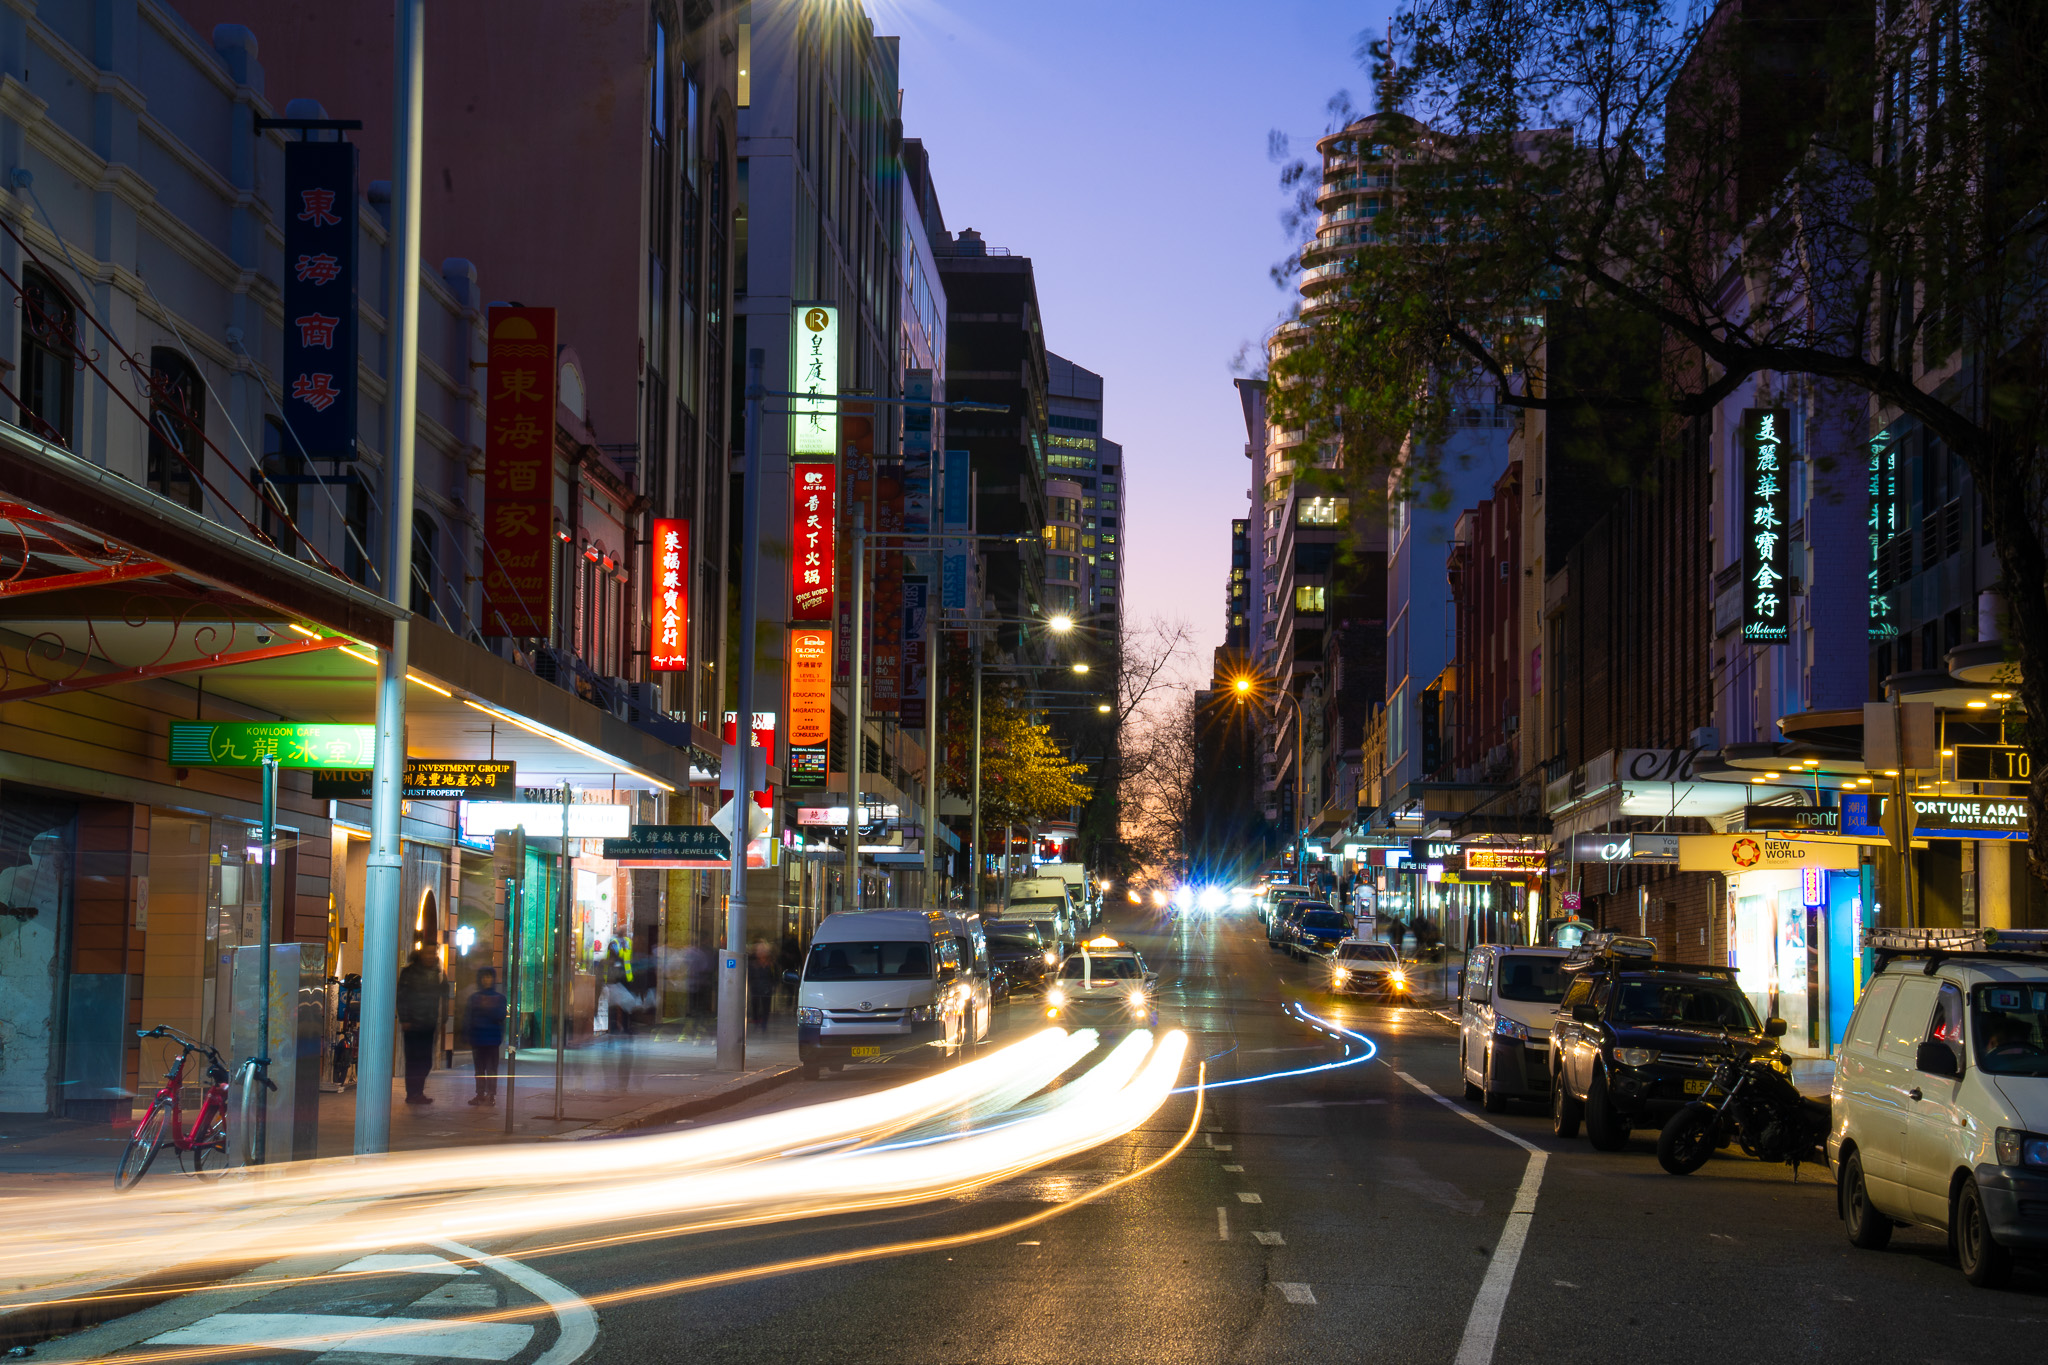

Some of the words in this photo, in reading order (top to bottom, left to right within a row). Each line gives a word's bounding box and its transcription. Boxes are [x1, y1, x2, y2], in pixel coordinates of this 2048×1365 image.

[294, 187, 342, 412] 東海商場
[493, 367, 545, 538] 東海酒家
[1752, 413, 1783, 618] 美麗華珠寶金行
[487, 569, 545, 590] Ocean
[943, 555, 957, 607] SUSSEX
[246, 727, 293, 737] KOWLOON
[296, 727, 322, 738] CAFE
[216, 737, 353, 766] 九龍冰室
[418, 764, 476, 774] INVESTMENT
[478, 764, 511, 774] GROUP
[407, 789, 426, 797] JUST
[426, 789, 465, 798] PROPERTY
[1912, 801, 1981, 816] ORTUNE
[1950, 815, 2018, 825] AUSTRALIA
[616, 831, 721, 844] 氏鐘錶首飾行
[609, 847, 637, 855] SHUM'S
[680, 848, 724, 856] JEWELLERY
[1765, 842, 1791, 850] NEW
[1476, 855, 1535, 864] PROSPERITY
[1766, 850, 1806, 859] WORLD
[1685, 1081, 1697, 1091] CR
